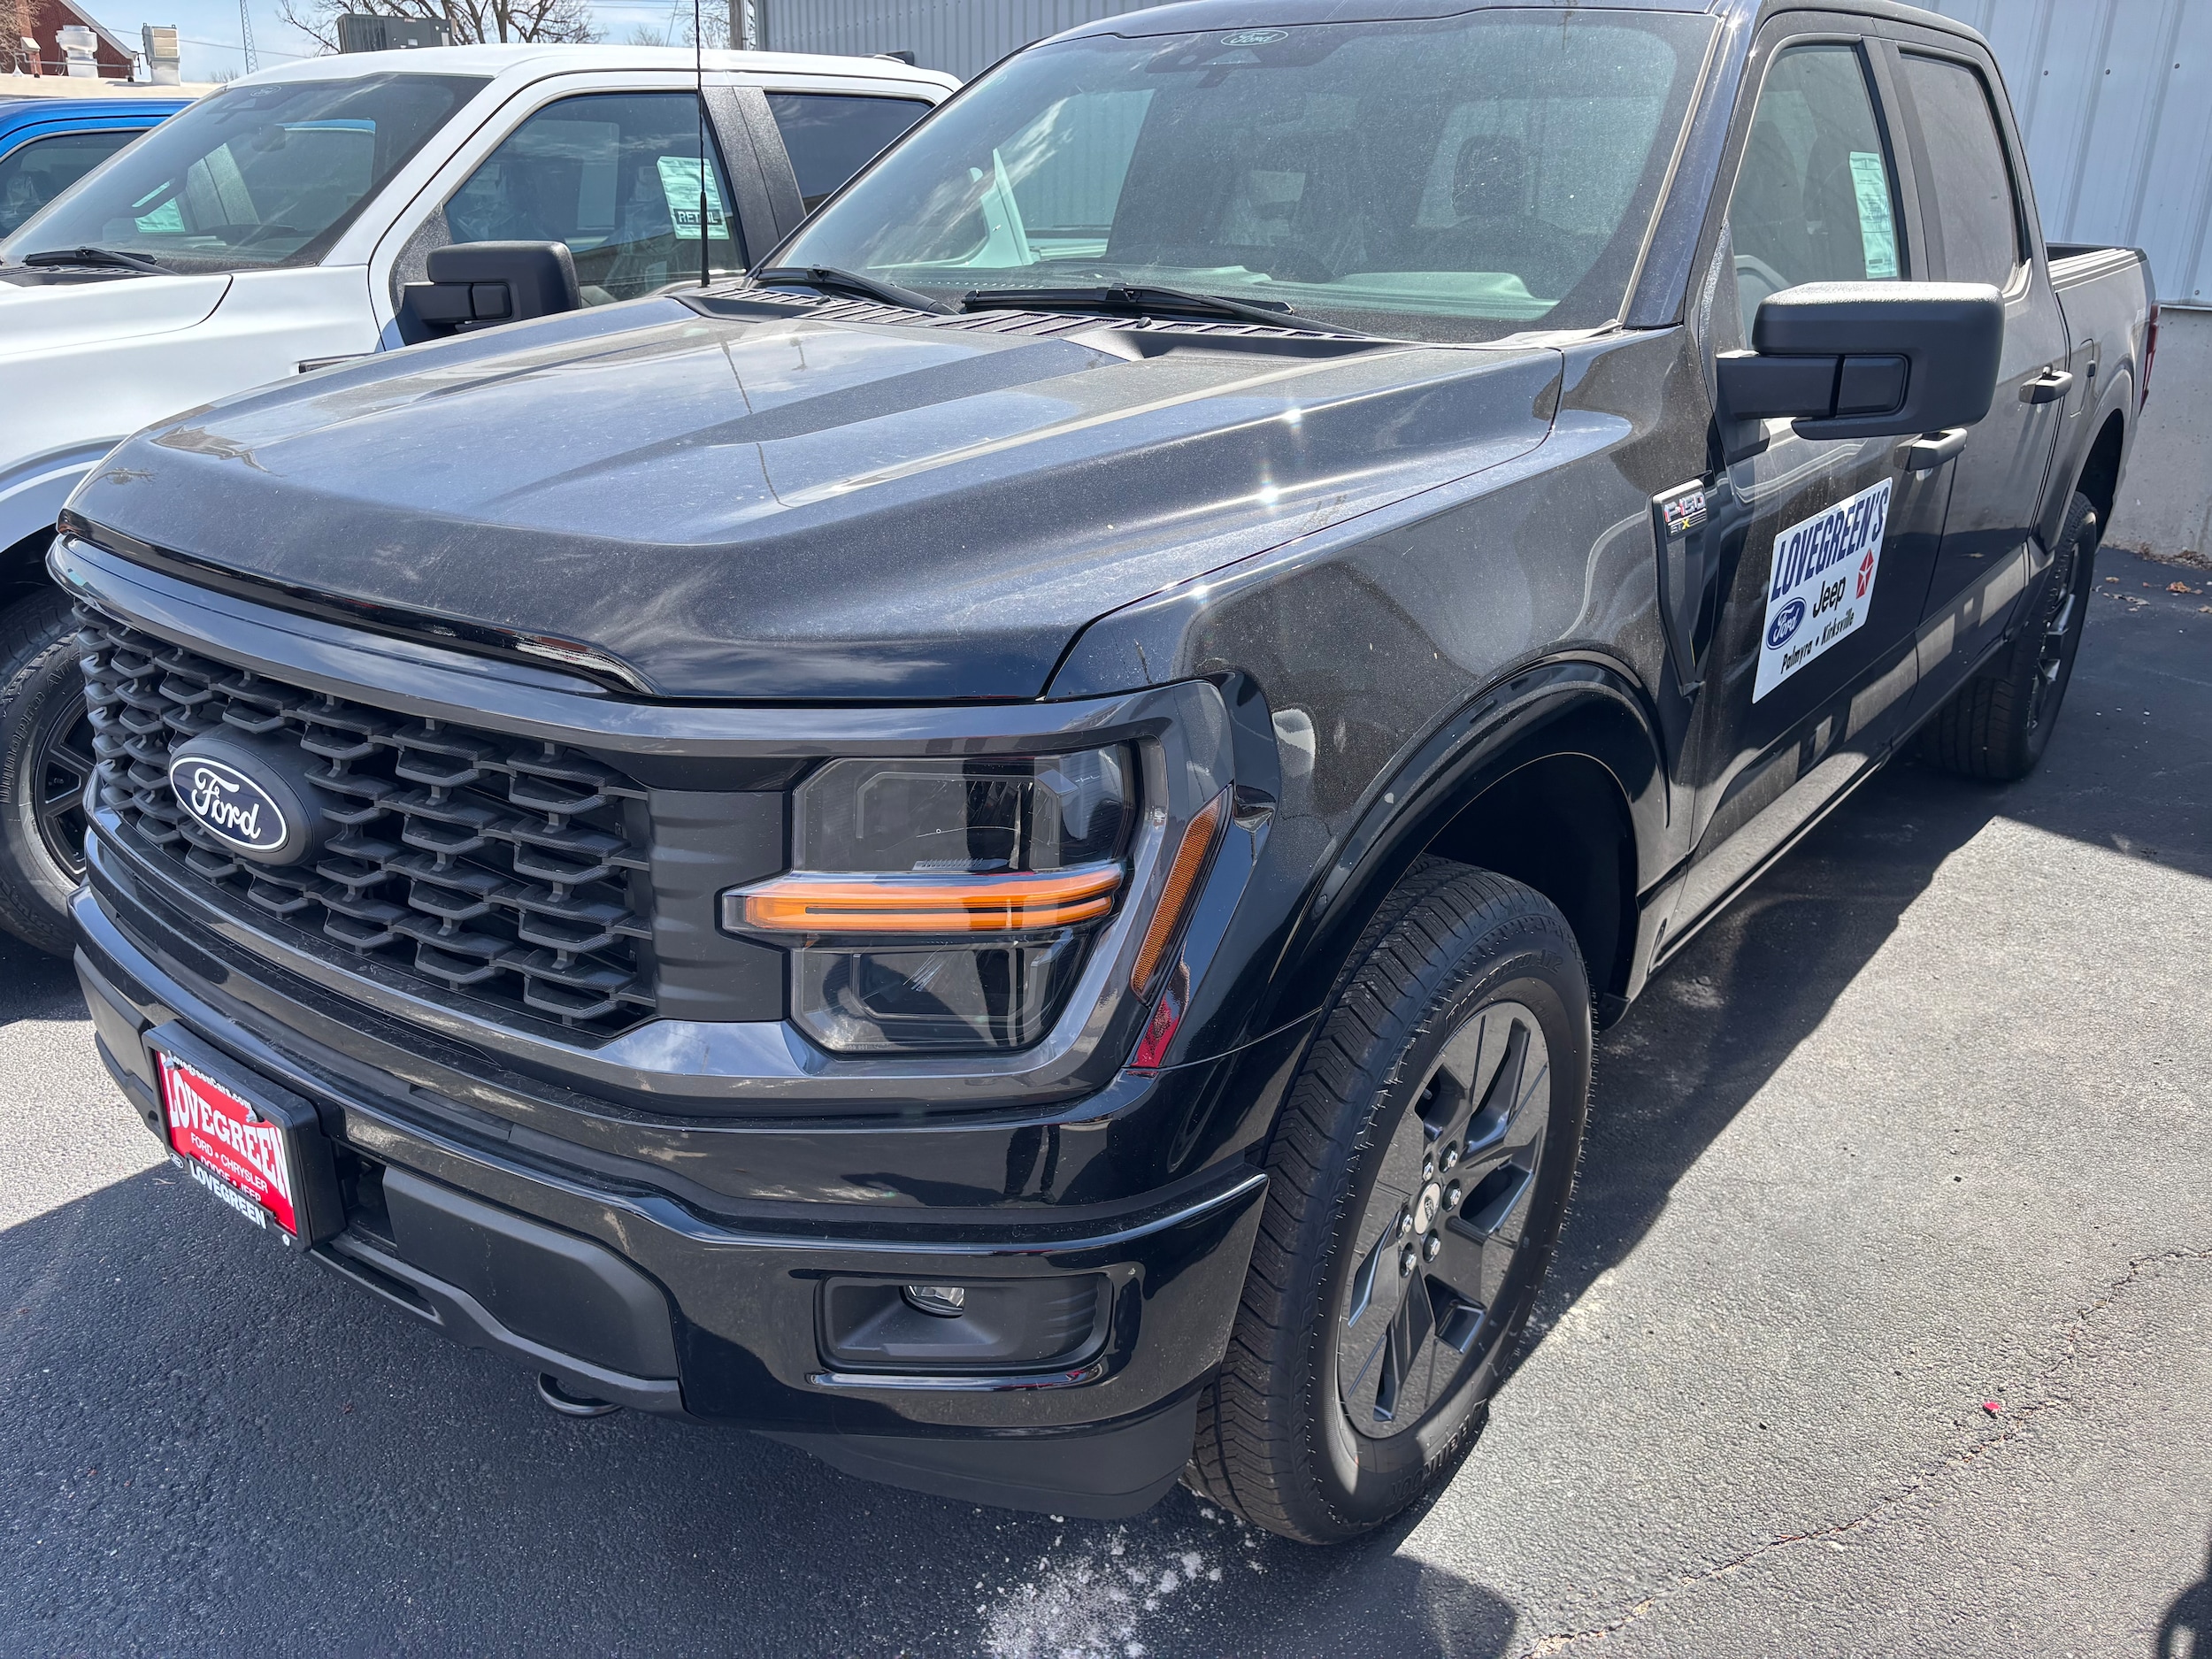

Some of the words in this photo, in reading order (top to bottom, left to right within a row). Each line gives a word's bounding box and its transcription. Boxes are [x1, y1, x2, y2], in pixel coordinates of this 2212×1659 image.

[1230, 32, 1279, 43] Ford
[678, 211, 718, 223] RETIL
[1770, 487, 1889, 603] LOVEGREEN'S
[1772, 604, 1801, 642] Ford
[1812, 576, 1847, 618] Jeep
[1780, 641, 1812, 675] Palmyra
[1821, 607, 1855, 646] Kirksville
[191, 767, 262, 840] Ford
[160, 1052, 294, 1209] LOVEGREEN
[190, 1132, 214, 1157] FORD
[220, 1154, 269, 1194] CHRYSLER
[188, 1159, 266, 1230] LOVEGREEN
